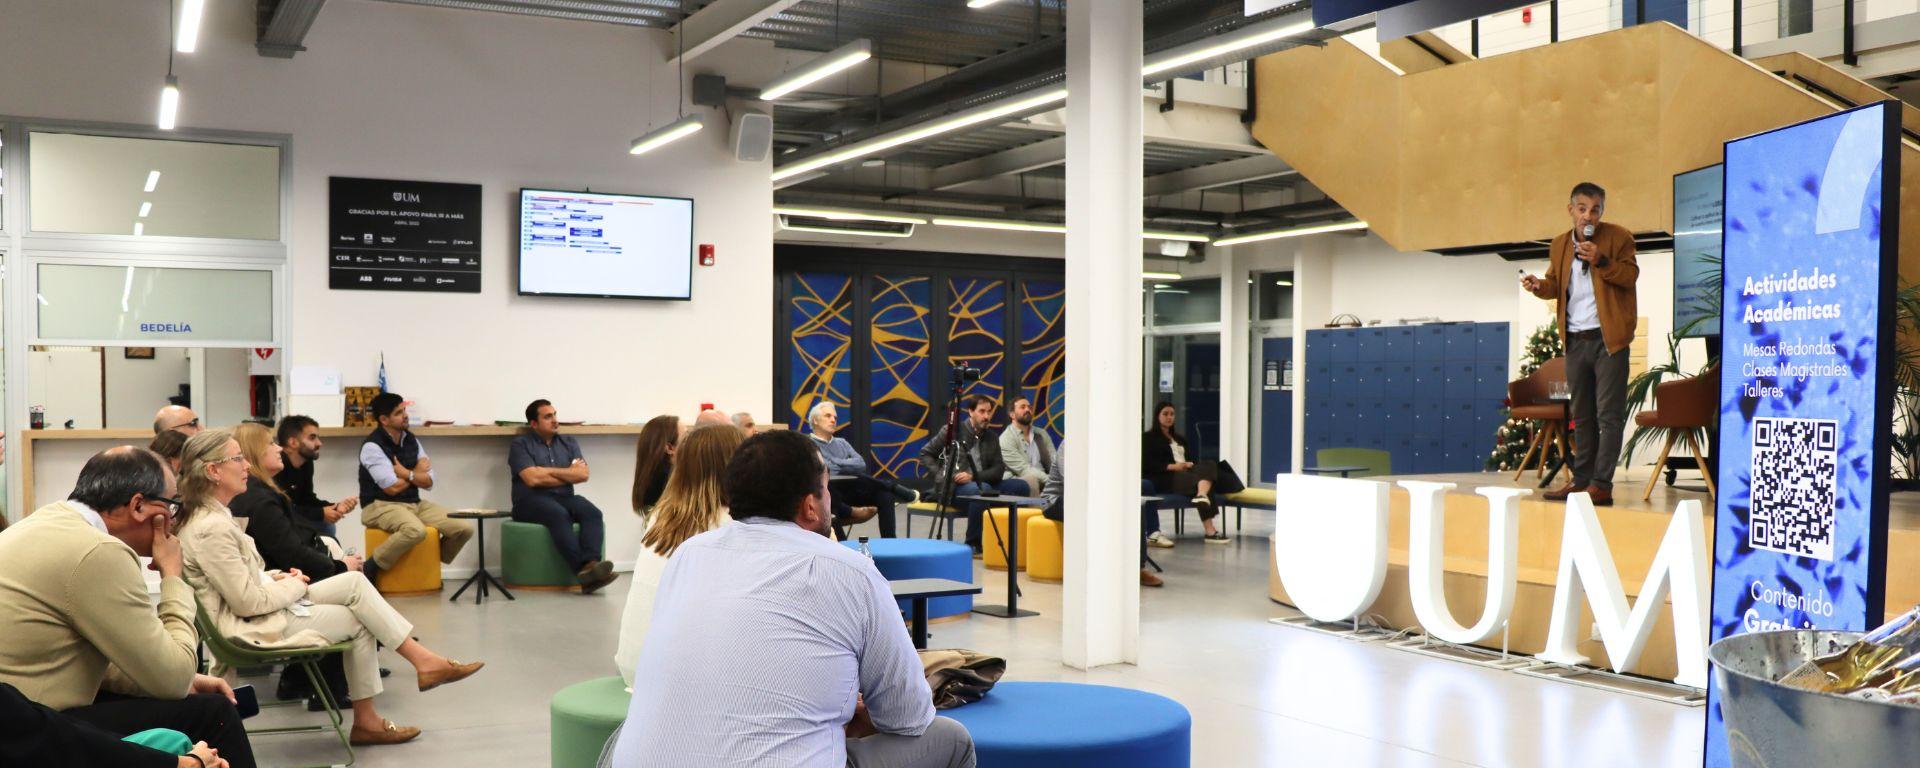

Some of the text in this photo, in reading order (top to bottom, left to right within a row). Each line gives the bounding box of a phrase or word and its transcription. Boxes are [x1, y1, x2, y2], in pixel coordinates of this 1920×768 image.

[1743, 267, 1837, 296] Actividades
[1743, 299, 1841, 324] Académicas
[140, 322, 192, 333] BEDELÍA
[1743, 336, 1836, 357] Mesas Redondas
[1743, 358, 1848, 382] Clases Magistrales
[1743, 380, 1784, 398] Talleres
[1751, 580, 1834, 617] Contenido
